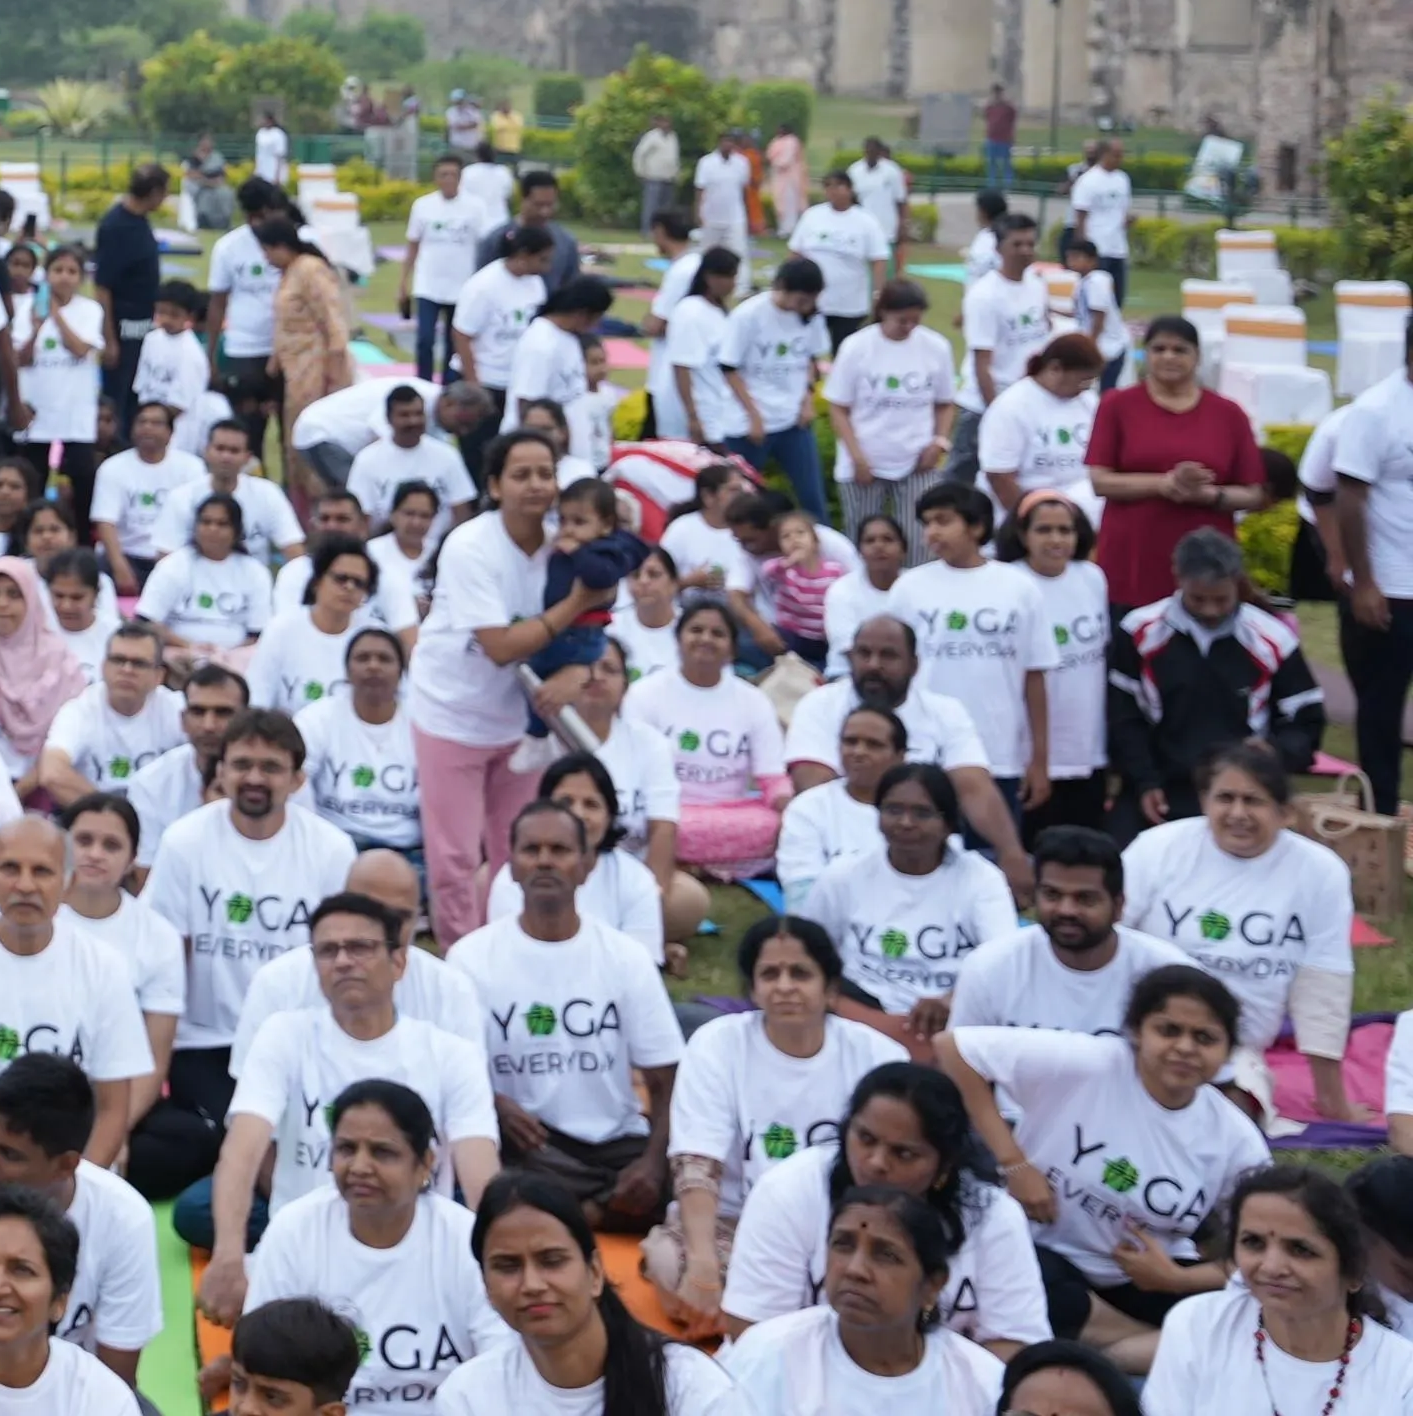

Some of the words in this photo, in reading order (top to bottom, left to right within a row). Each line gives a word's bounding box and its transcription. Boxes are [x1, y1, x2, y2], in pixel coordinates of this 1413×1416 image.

[198, 886, 314, 932] YOGA
[1163, 900, 1305, 946] YOGA
[849, 923, 975, 960] YOGA
[491, 1000, 621, 1042] YOGA
[1072, 1126, 1208, 1221] YOGA
